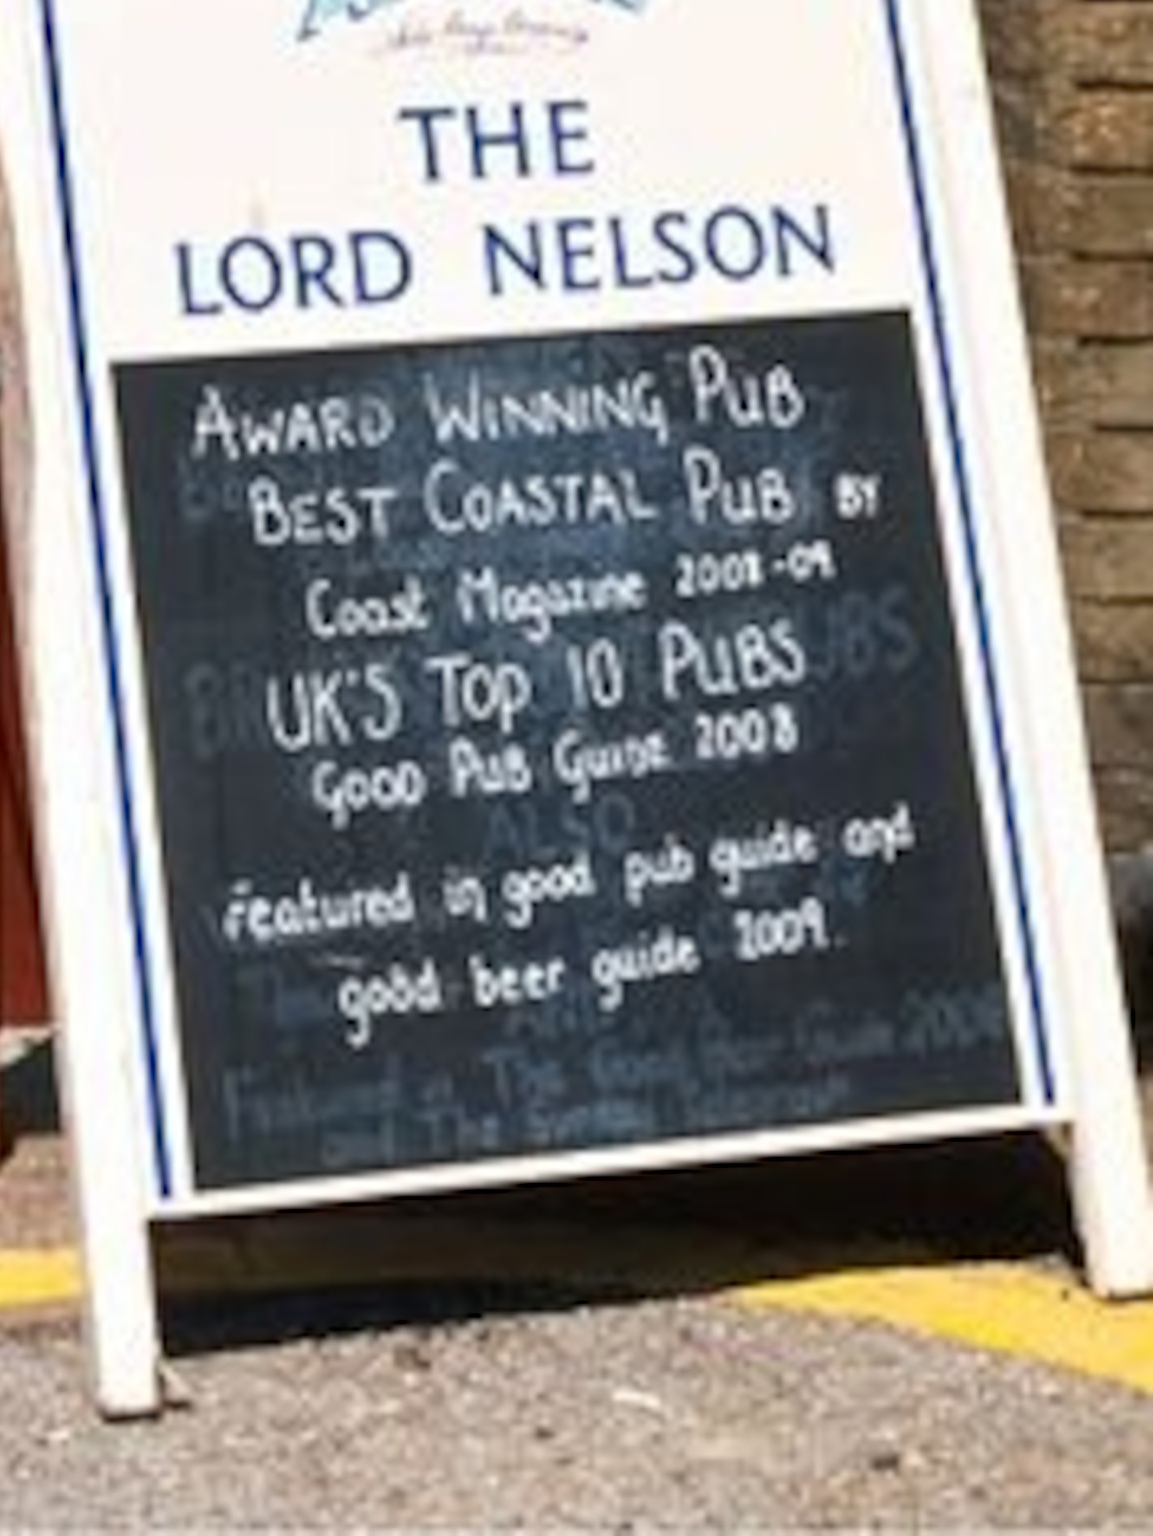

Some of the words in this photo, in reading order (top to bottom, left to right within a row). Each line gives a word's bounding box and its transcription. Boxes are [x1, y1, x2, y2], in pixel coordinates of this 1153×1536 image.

[397, 98, 596, 185] THE
[174, 229, 413, 317] LORD
[482, 203, 836, 298] NELSON
[191, 384, 395, 461] AWARD
[425, 370, 669, 447] WINNING
[249, 477, 396, 546] BEST
[423, 461, 658, 536] COASTAL
[835, 474, 881, 519] BY
[306, 578, 428, 638] Coast
[458, 564, 647, 644] Magazine
[567, 638, 625, 710] 10
[662, 620, 806, 702] PUBS
[695, 704, 799, 760] 2008
[445, 872, 488, 920] in
[502, 862, 594, 929] good
[624, 833, 696, 892] pub
[711, 814, 817, 888] guide
[844, 802, 916, 862] and
[337, 975, 441, 1049] good
[471, 954, 566, 1011] beer
[591, 932, 701, 1011] guide
